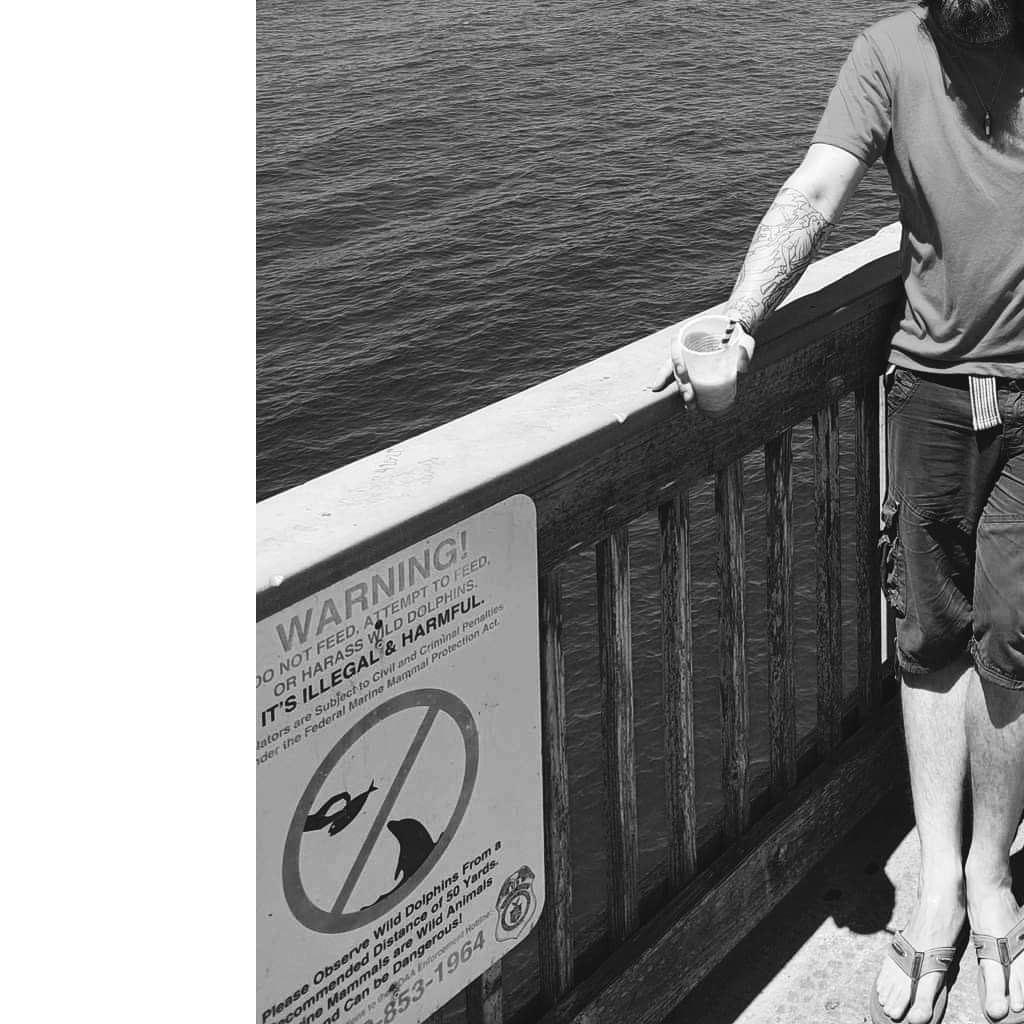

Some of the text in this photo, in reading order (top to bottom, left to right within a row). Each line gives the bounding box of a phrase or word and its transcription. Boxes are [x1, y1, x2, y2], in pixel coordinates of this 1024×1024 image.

[275, 531, 467, 652] WARNING!
[280, 647, 312, 675] NOT
[364, 585, 429, 630] ATTEMPT
[432, 575, 449, 592] TO
[262, 595, 485, 727] IT'S ILLEGAL & HARMFUL.
[274, 676, 297, 697] OR
[302, 639, 364, 682] HARASS
[367, 618, 403, 644] WILD
[283, 734, 301, 750] the
[304, 705, 346, 737] Federal
[349, 685, 385, 712] Marine
[387, 657, 429, 688] Mammal
[431, 629, 480, 663] Protection
[293, 713, 312, 729] are
[315, 684, 357, 717] Subject
[359, 680, 370, 691] to
[372, 662, 396, 682] Civil
[398, 650, 417, 668] and
[419, 626, 460, 656] Criminal
[462, 604, 504, 633] Penalties
[262, 984, 309, 1024] Please
[313, 938, 370, 985] Observe
[373, 911, 401, 940] Wild
[405, 872, 459, 917] Dolphins
[462, 848, 491, 876] From
[494, 841, 503, 851] a
[270, 952, 369, 1024] ecommended
[373, 911, 428, 958] Distance
[431, 896, 443, 914] of
[447, 885, 459, 903] 50
[328, 955, 390, 1011] Mammals
[393, 938, 413, 958] are
[416, 912, 443, 939] Wild
[447, 877, 493, 919] Animals
[343, 987, 370, 1012] Can
[374, 972, 389, 989] be
[393, 913, 462, 975] Dangerous!
